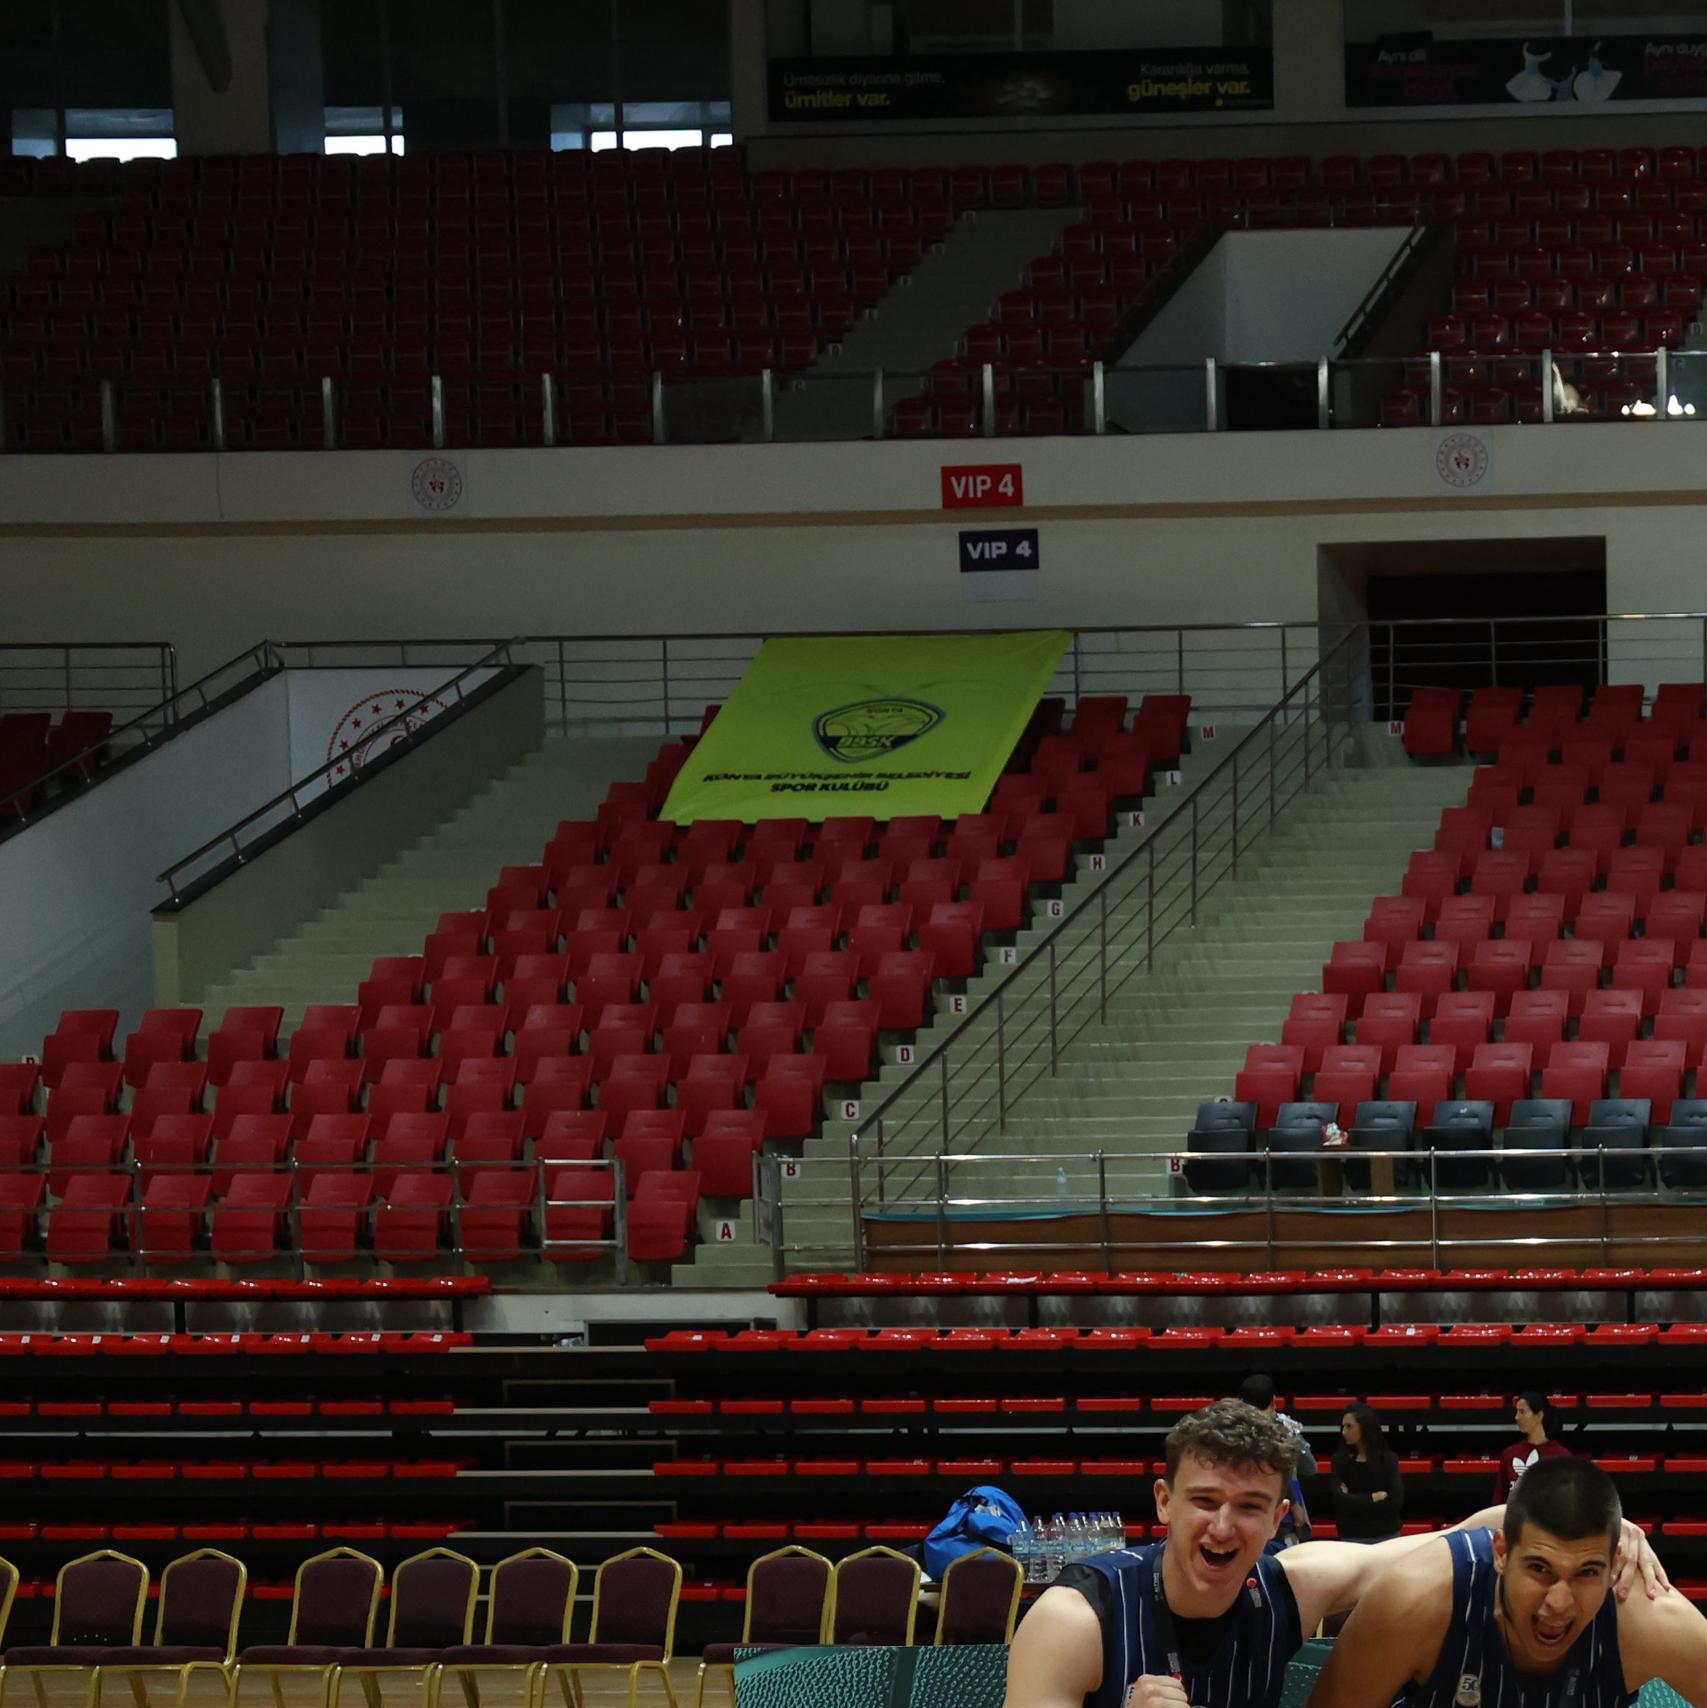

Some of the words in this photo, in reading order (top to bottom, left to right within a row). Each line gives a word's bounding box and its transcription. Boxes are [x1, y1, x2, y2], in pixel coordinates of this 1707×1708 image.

[951, 475, 993, 499] VIP
[998, 473, 1015, 497] 4
[967, 541, 1008, 559] VIP
[1015, 540, 1032, 558] 4
[770, 782, 817, 792] SPOR
[819, 781, 889, 792] KULÜBÜ
[954, 998, 963, 1012] E
[901, 1047, 910, 1062] D
[845, 1103, 855, 1117] C
[787, 1162, 796, 1176] B
[721, 1222, 733, 1240] A
